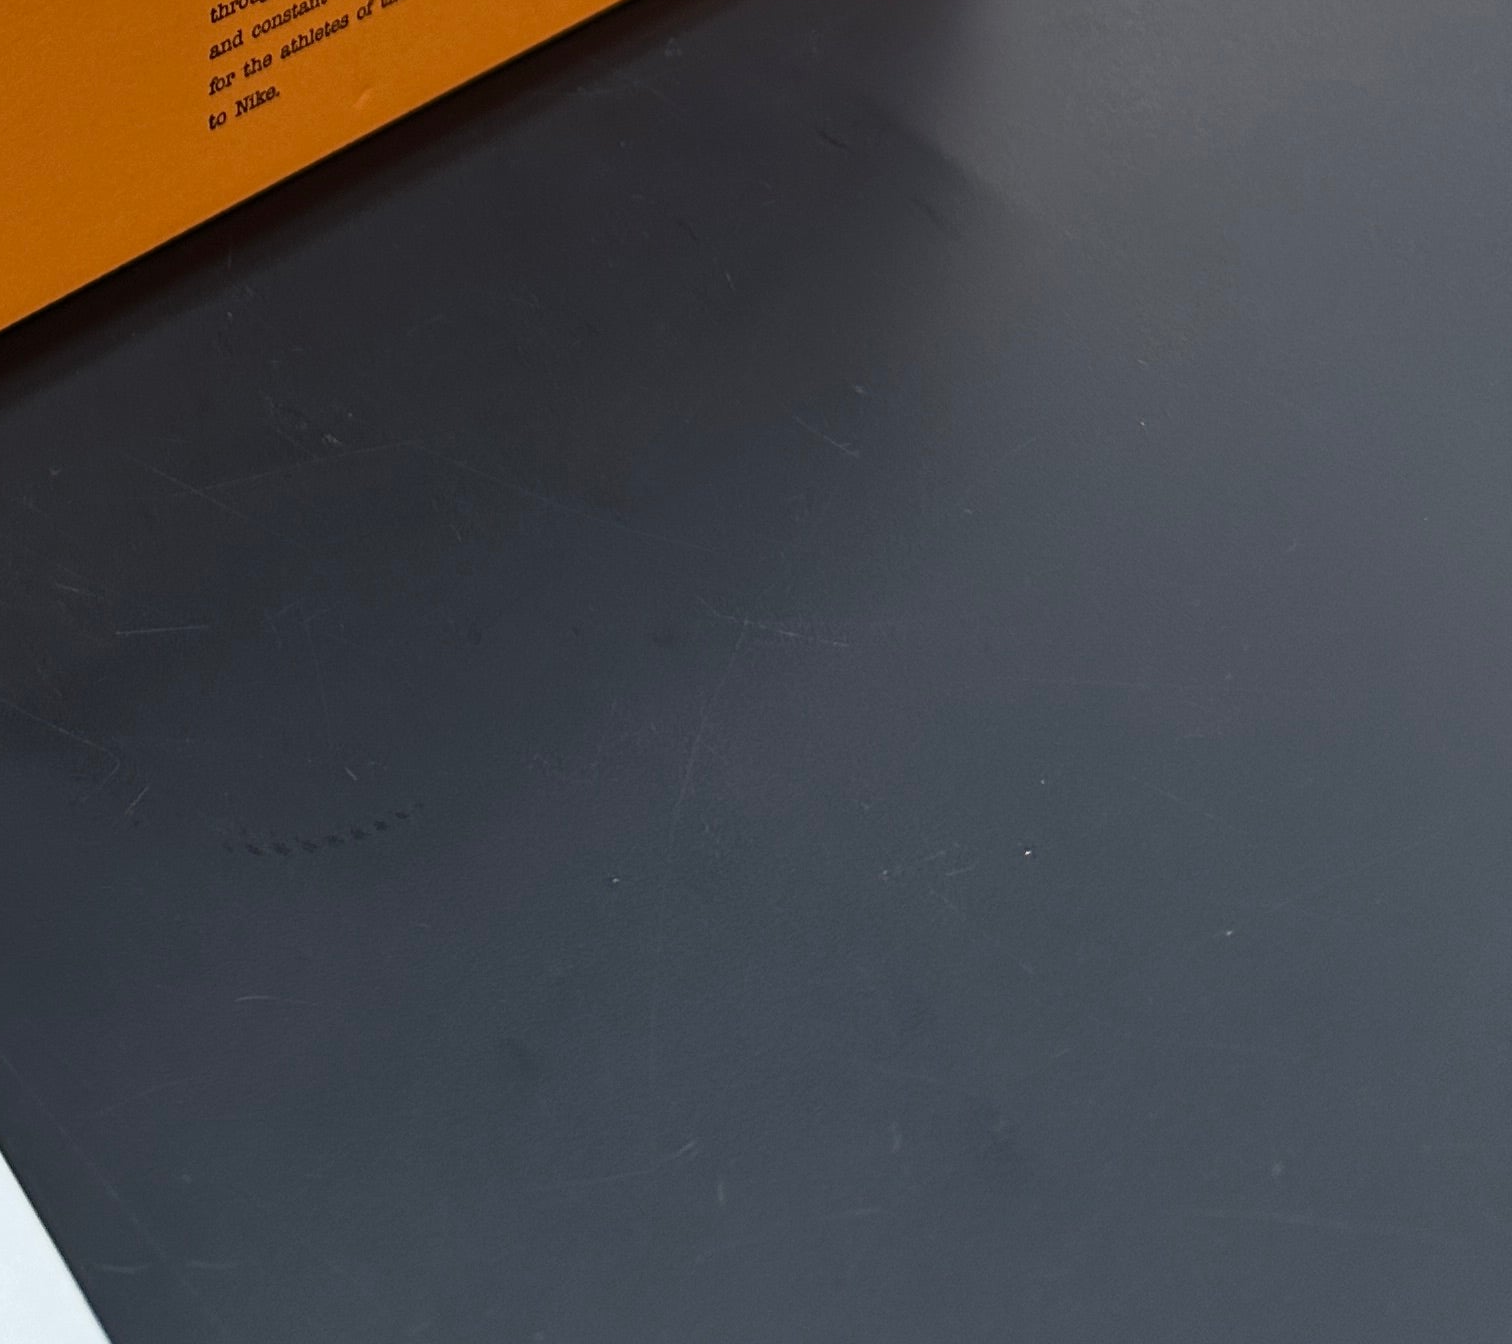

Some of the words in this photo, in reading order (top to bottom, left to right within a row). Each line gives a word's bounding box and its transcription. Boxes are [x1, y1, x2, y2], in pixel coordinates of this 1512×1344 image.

[209, 30, 243, 60] and
[209, 72, 235, 95] for
[242, 53, 272, 77] the
[280, 14, 349, 59] athletes
[208, 112, 226, 130] to
[235, 85, 280, 117] Nike.
